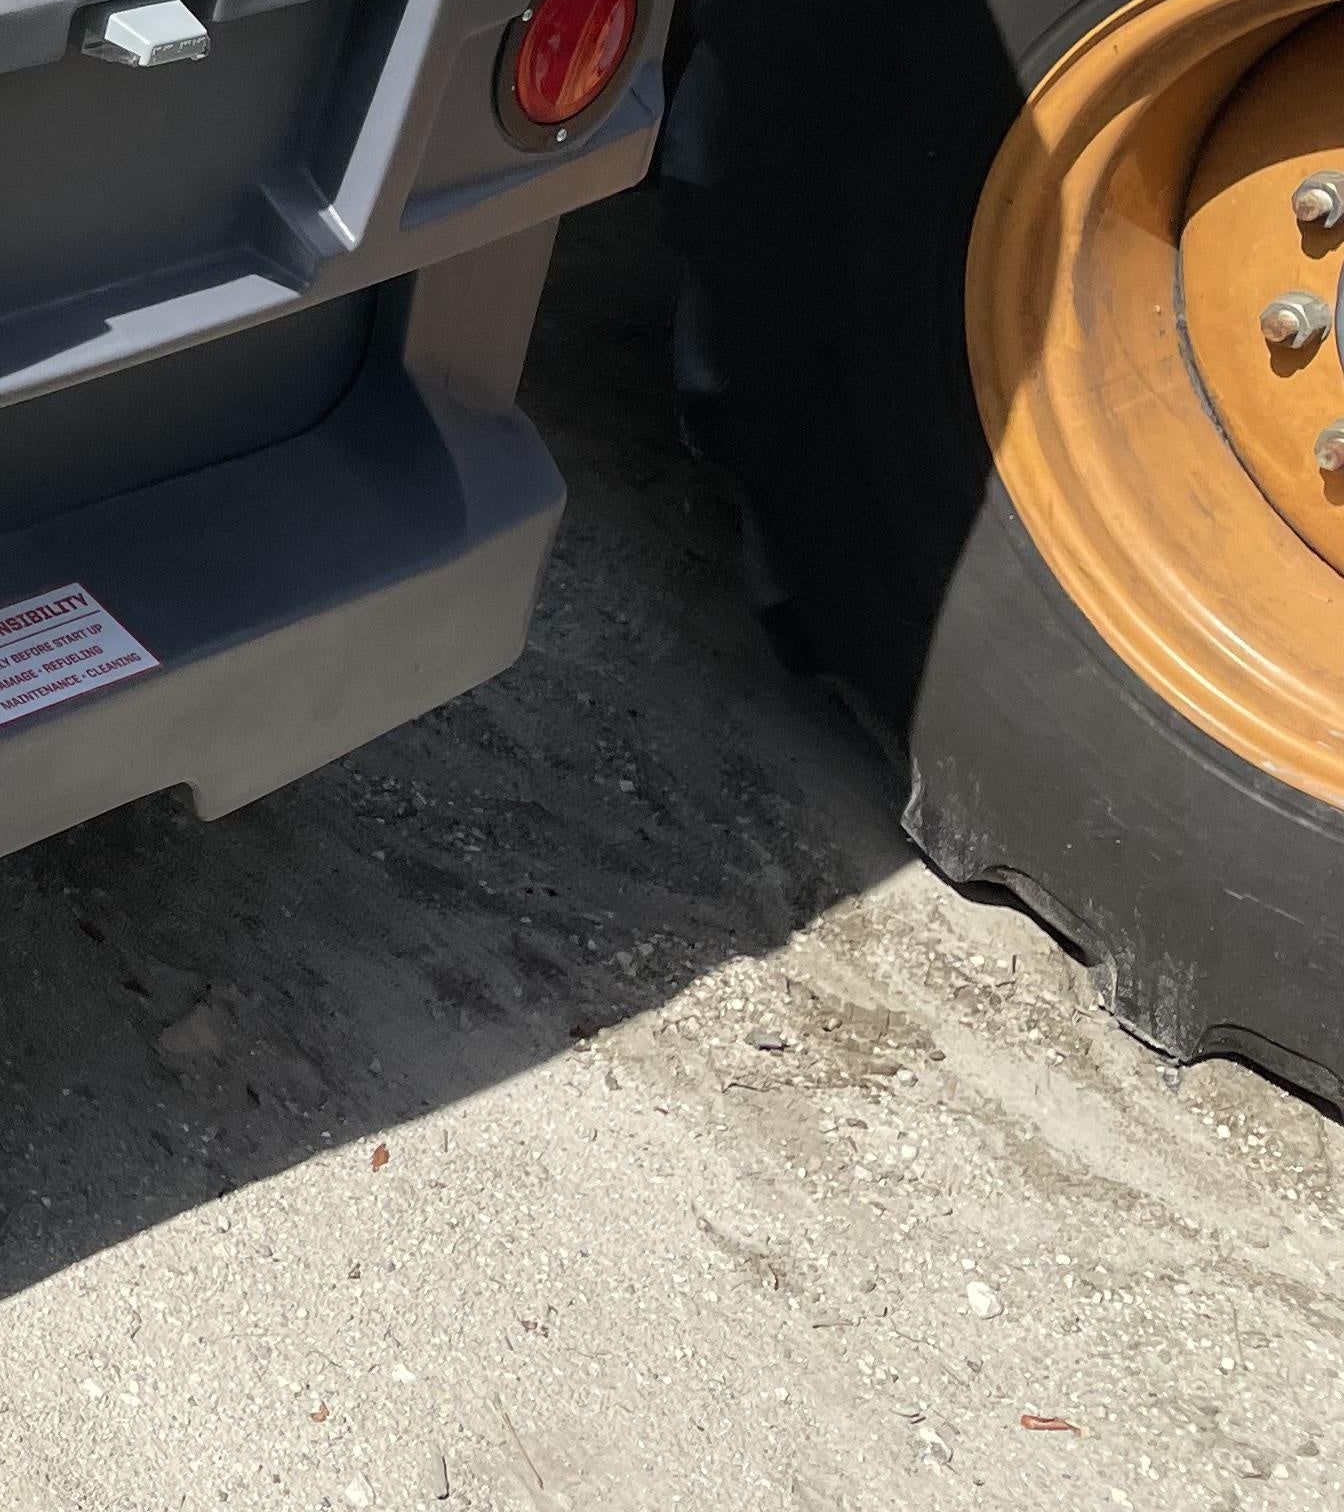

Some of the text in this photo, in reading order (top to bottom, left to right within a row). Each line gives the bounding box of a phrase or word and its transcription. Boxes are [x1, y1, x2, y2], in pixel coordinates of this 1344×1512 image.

[11, 642, 55, 664] BEFORE
[52, 630, 90, 649] START
[88, 623, 103, 636] UP
[41, 644, 104, 674] REFUELING
[0, 674, 82, 710] MAINTENANCE
[85, 652, 142, 678] CLEANING
